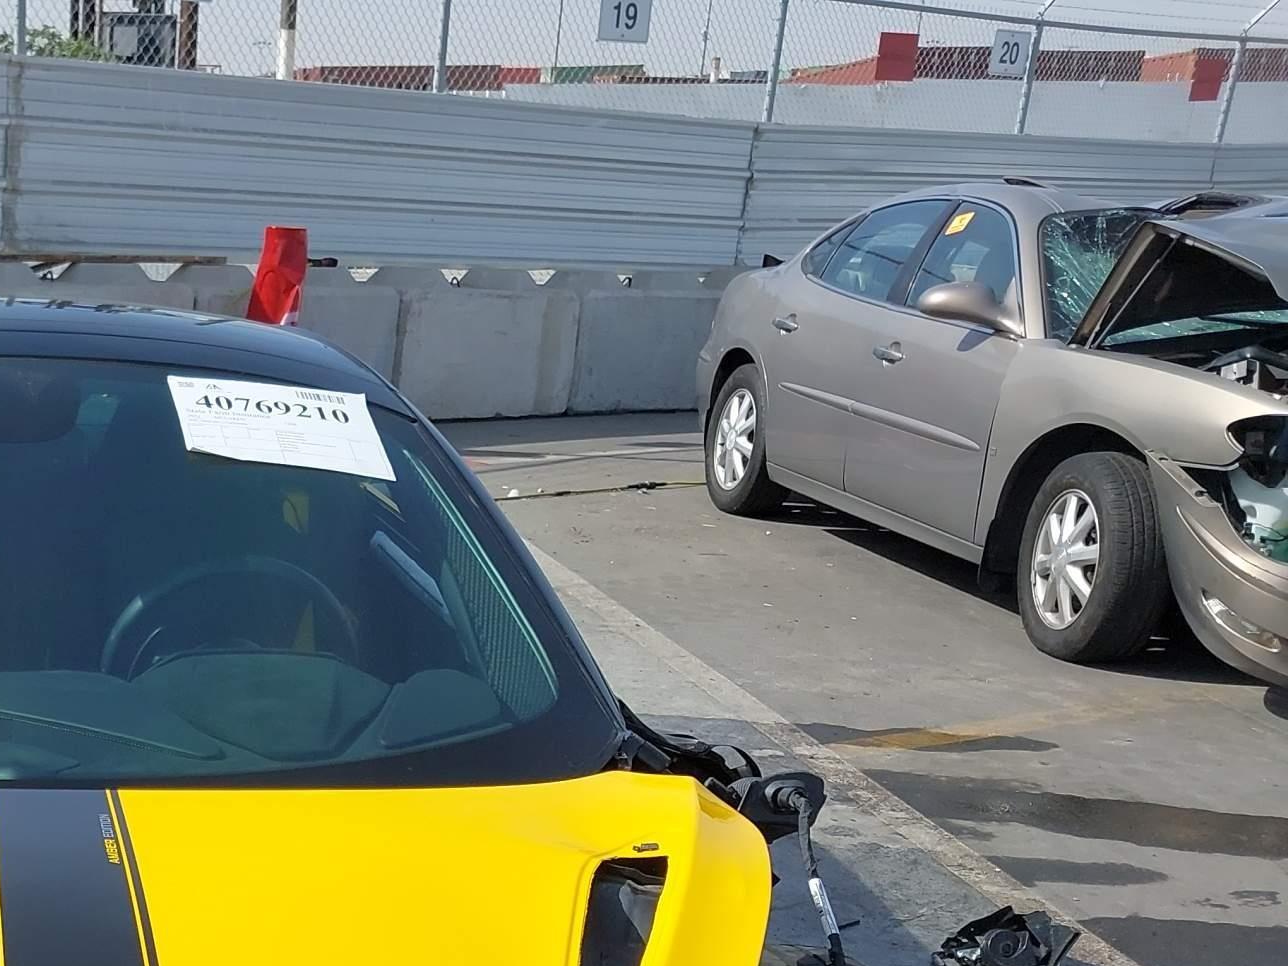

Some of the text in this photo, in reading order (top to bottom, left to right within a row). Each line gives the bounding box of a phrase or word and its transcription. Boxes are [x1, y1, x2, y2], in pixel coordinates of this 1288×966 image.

[613, 1, 638, 30] 19
[999, 41, 1020, 65] 20
[195, 395, 350, 424] 40769210
